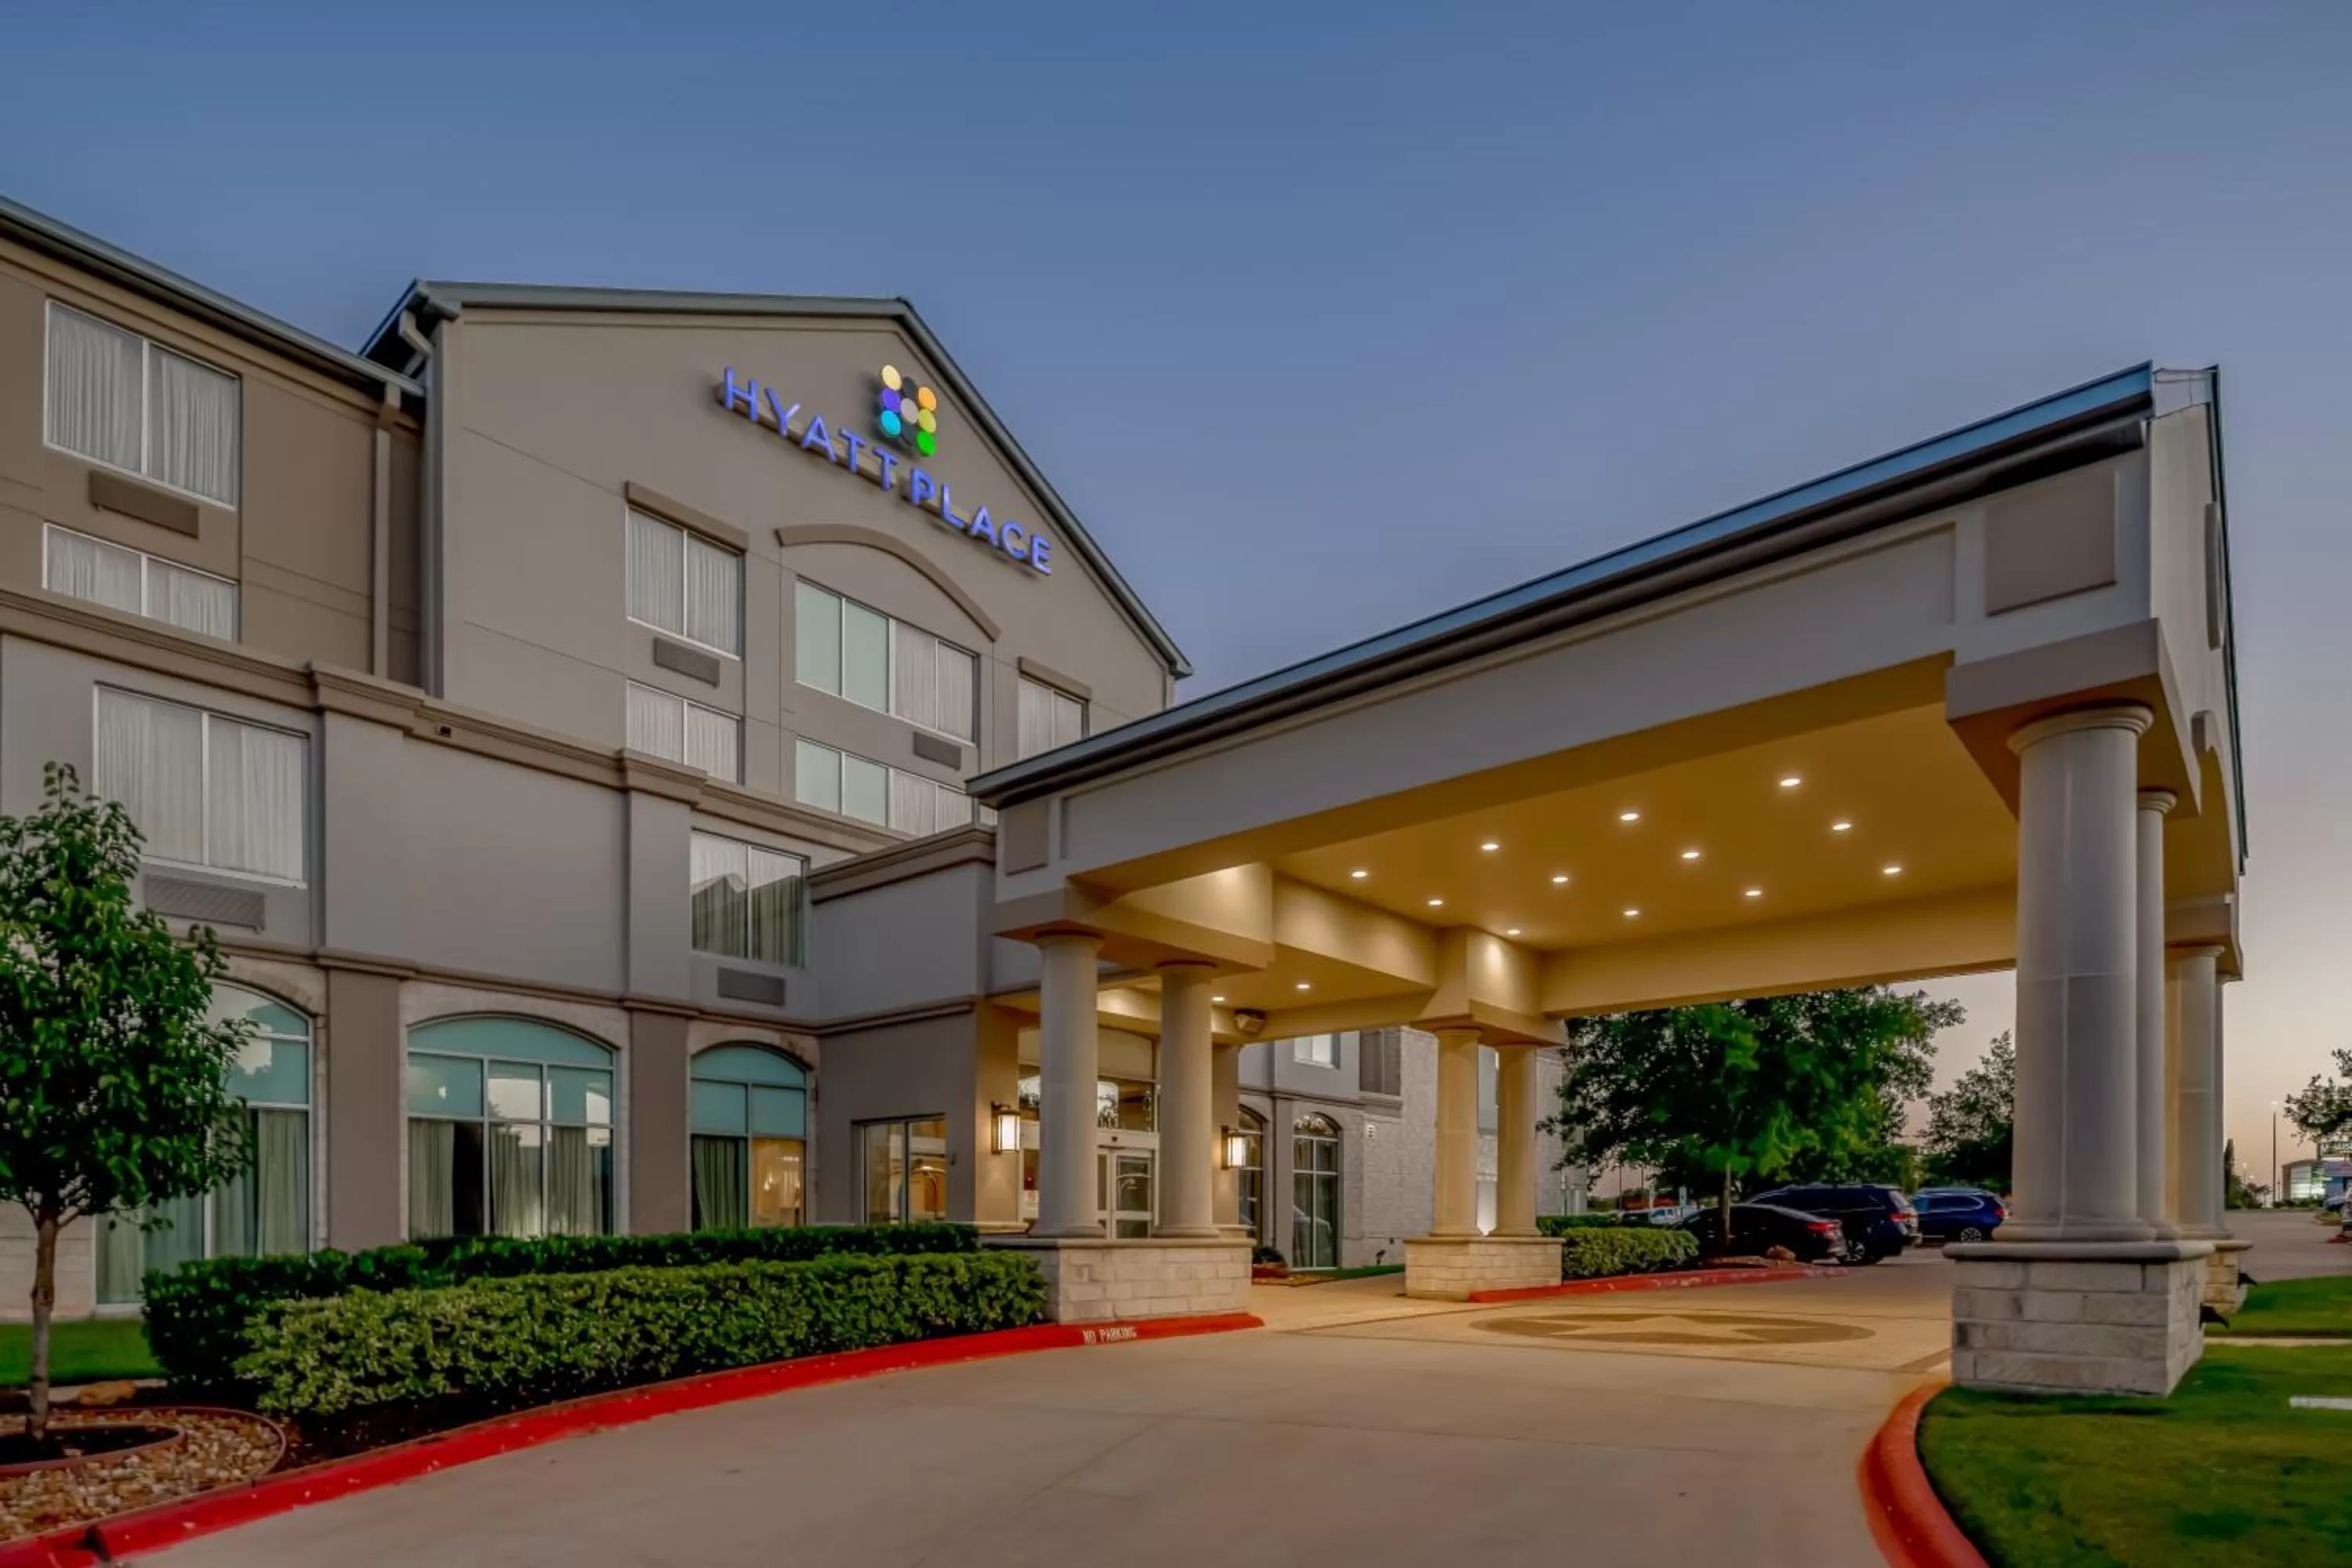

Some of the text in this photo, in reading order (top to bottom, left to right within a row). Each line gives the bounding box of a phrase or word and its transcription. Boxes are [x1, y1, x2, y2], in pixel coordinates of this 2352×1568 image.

[724, 366, 1052, 575] HYATT PLACE
[1082, 1327, 1138, 1343] NO PARKING
